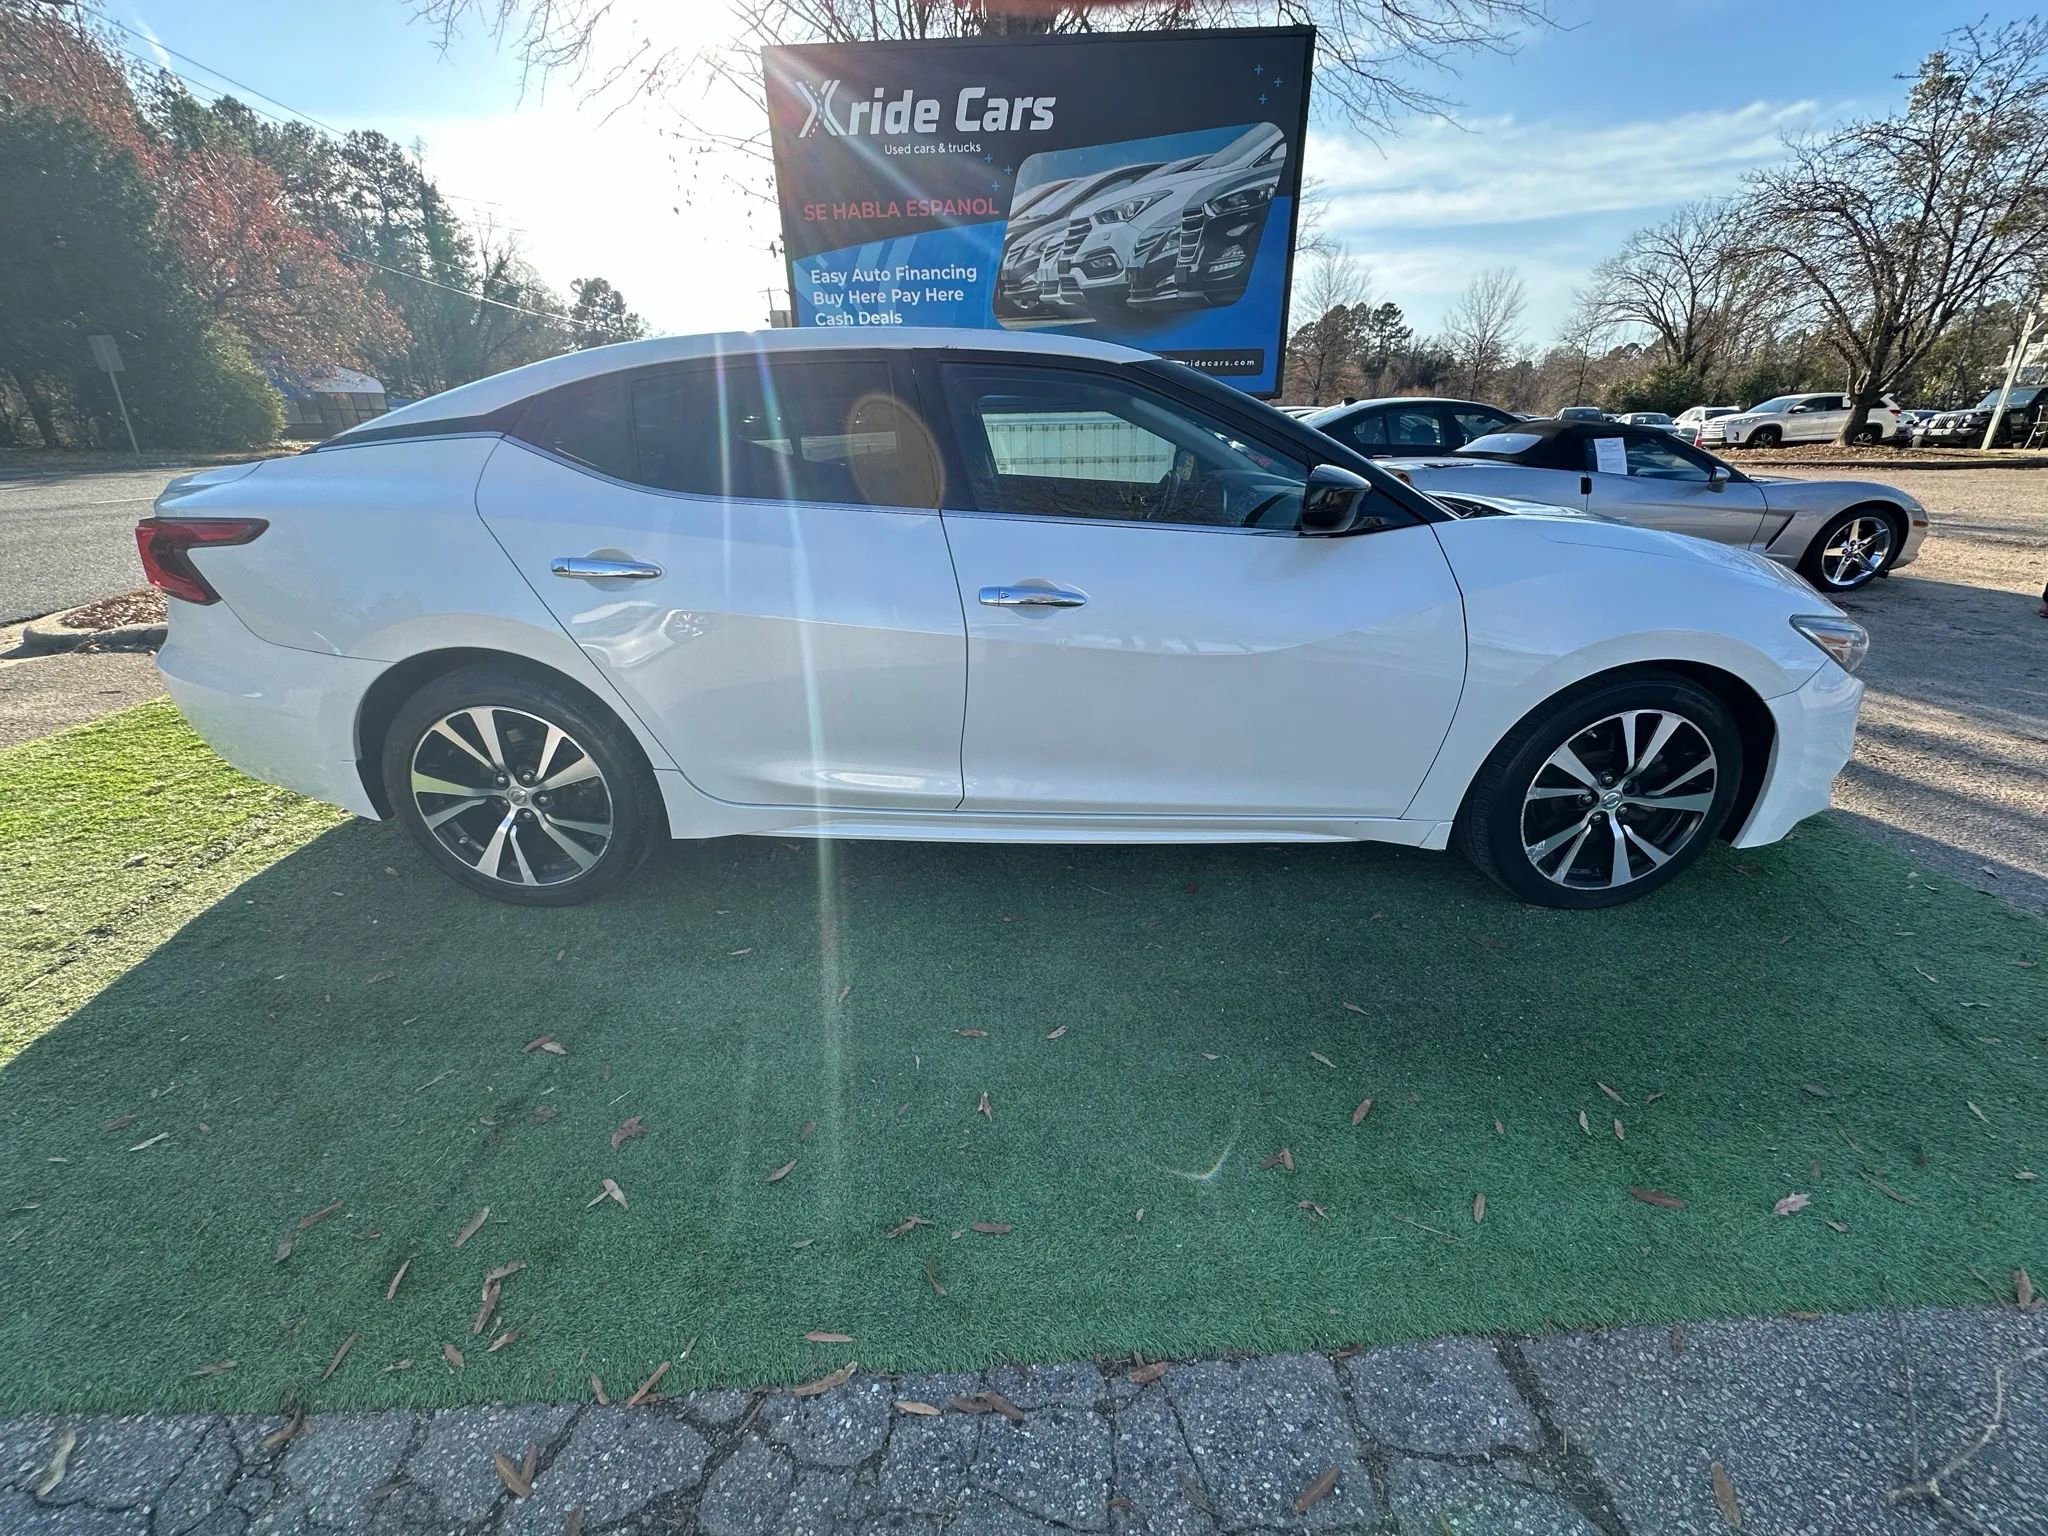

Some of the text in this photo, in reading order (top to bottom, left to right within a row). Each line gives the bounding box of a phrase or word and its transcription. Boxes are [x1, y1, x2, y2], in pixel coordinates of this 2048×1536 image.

[955, 87, 1057, 132] Cars
[884, 141, 982, 155] Used cars & trucks
[804, 197, 1000, 221] SE HABLA ESPANOL
[811, 264, 977, 287] Easy Auto Financing
[813, 287, 965, 307] Buy Here Pay Here
[815, 309, 903, 327] Cash Deals
